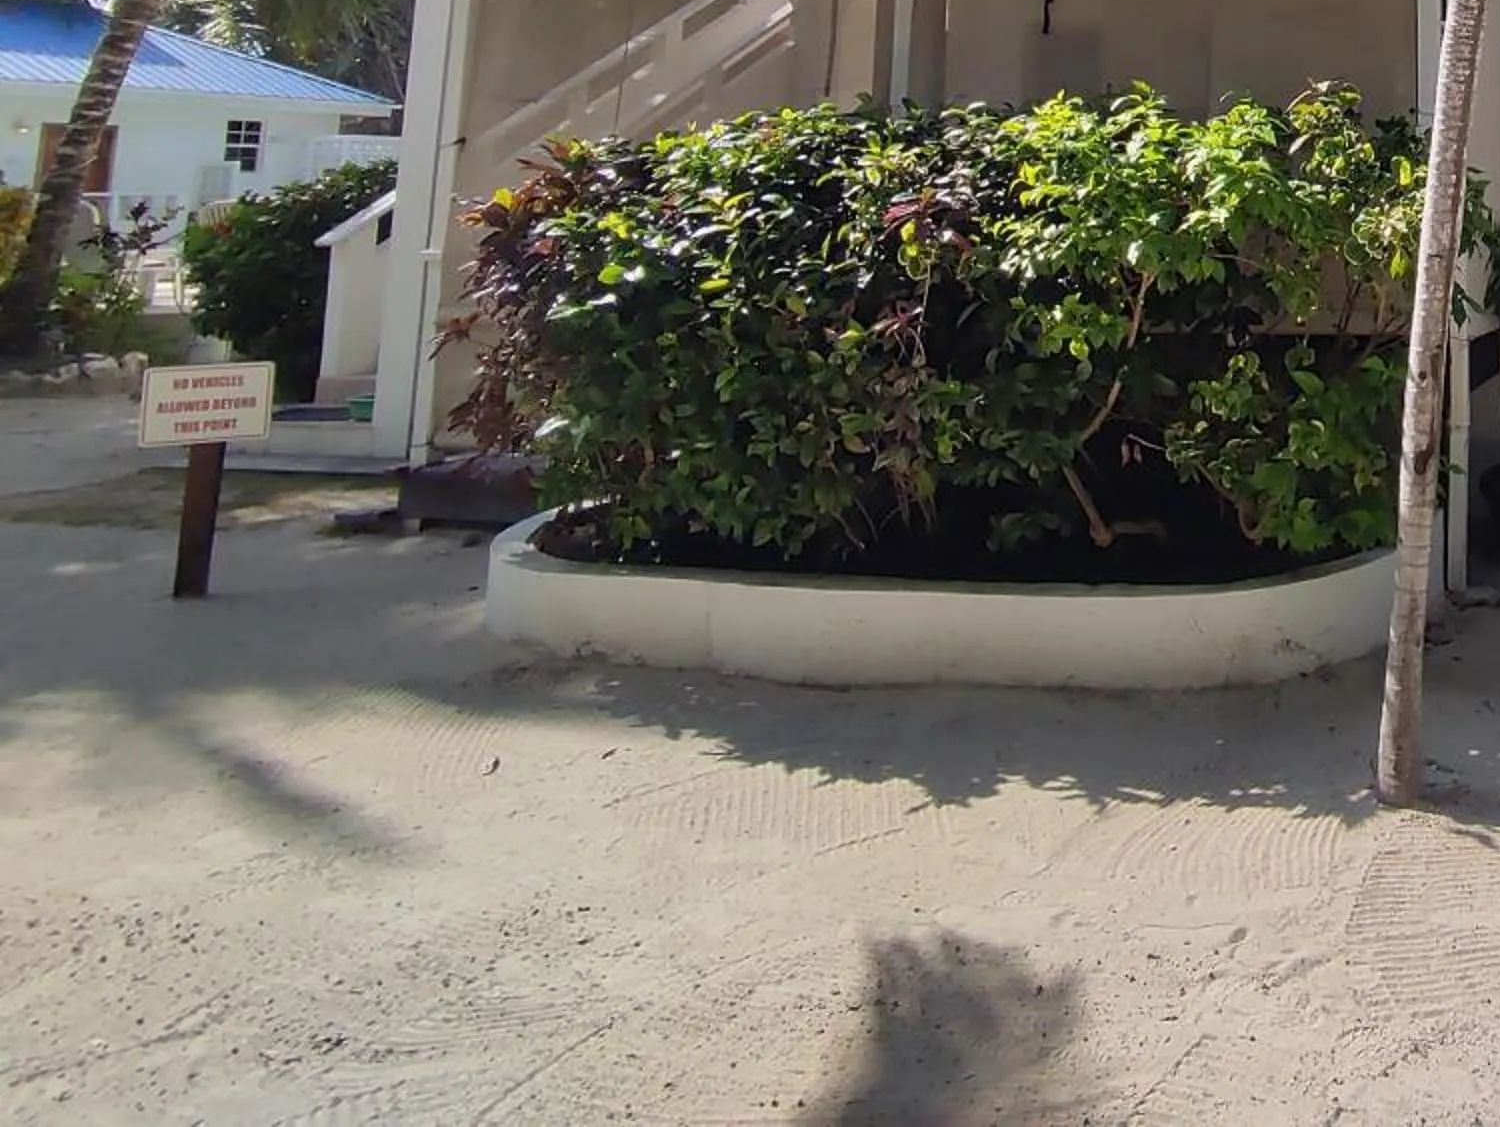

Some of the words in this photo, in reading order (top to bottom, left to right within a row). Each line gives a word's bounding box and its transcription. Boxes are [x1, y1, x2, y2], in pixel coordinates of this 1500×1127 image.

[172, 377, 189, 390] NO
[157, 399, 210, 414] ALLOWED
[212, 396, 257, 410] BEYOND
[174, 420, 201, 433] THIS
[202, 418, 238, 432] POINT
